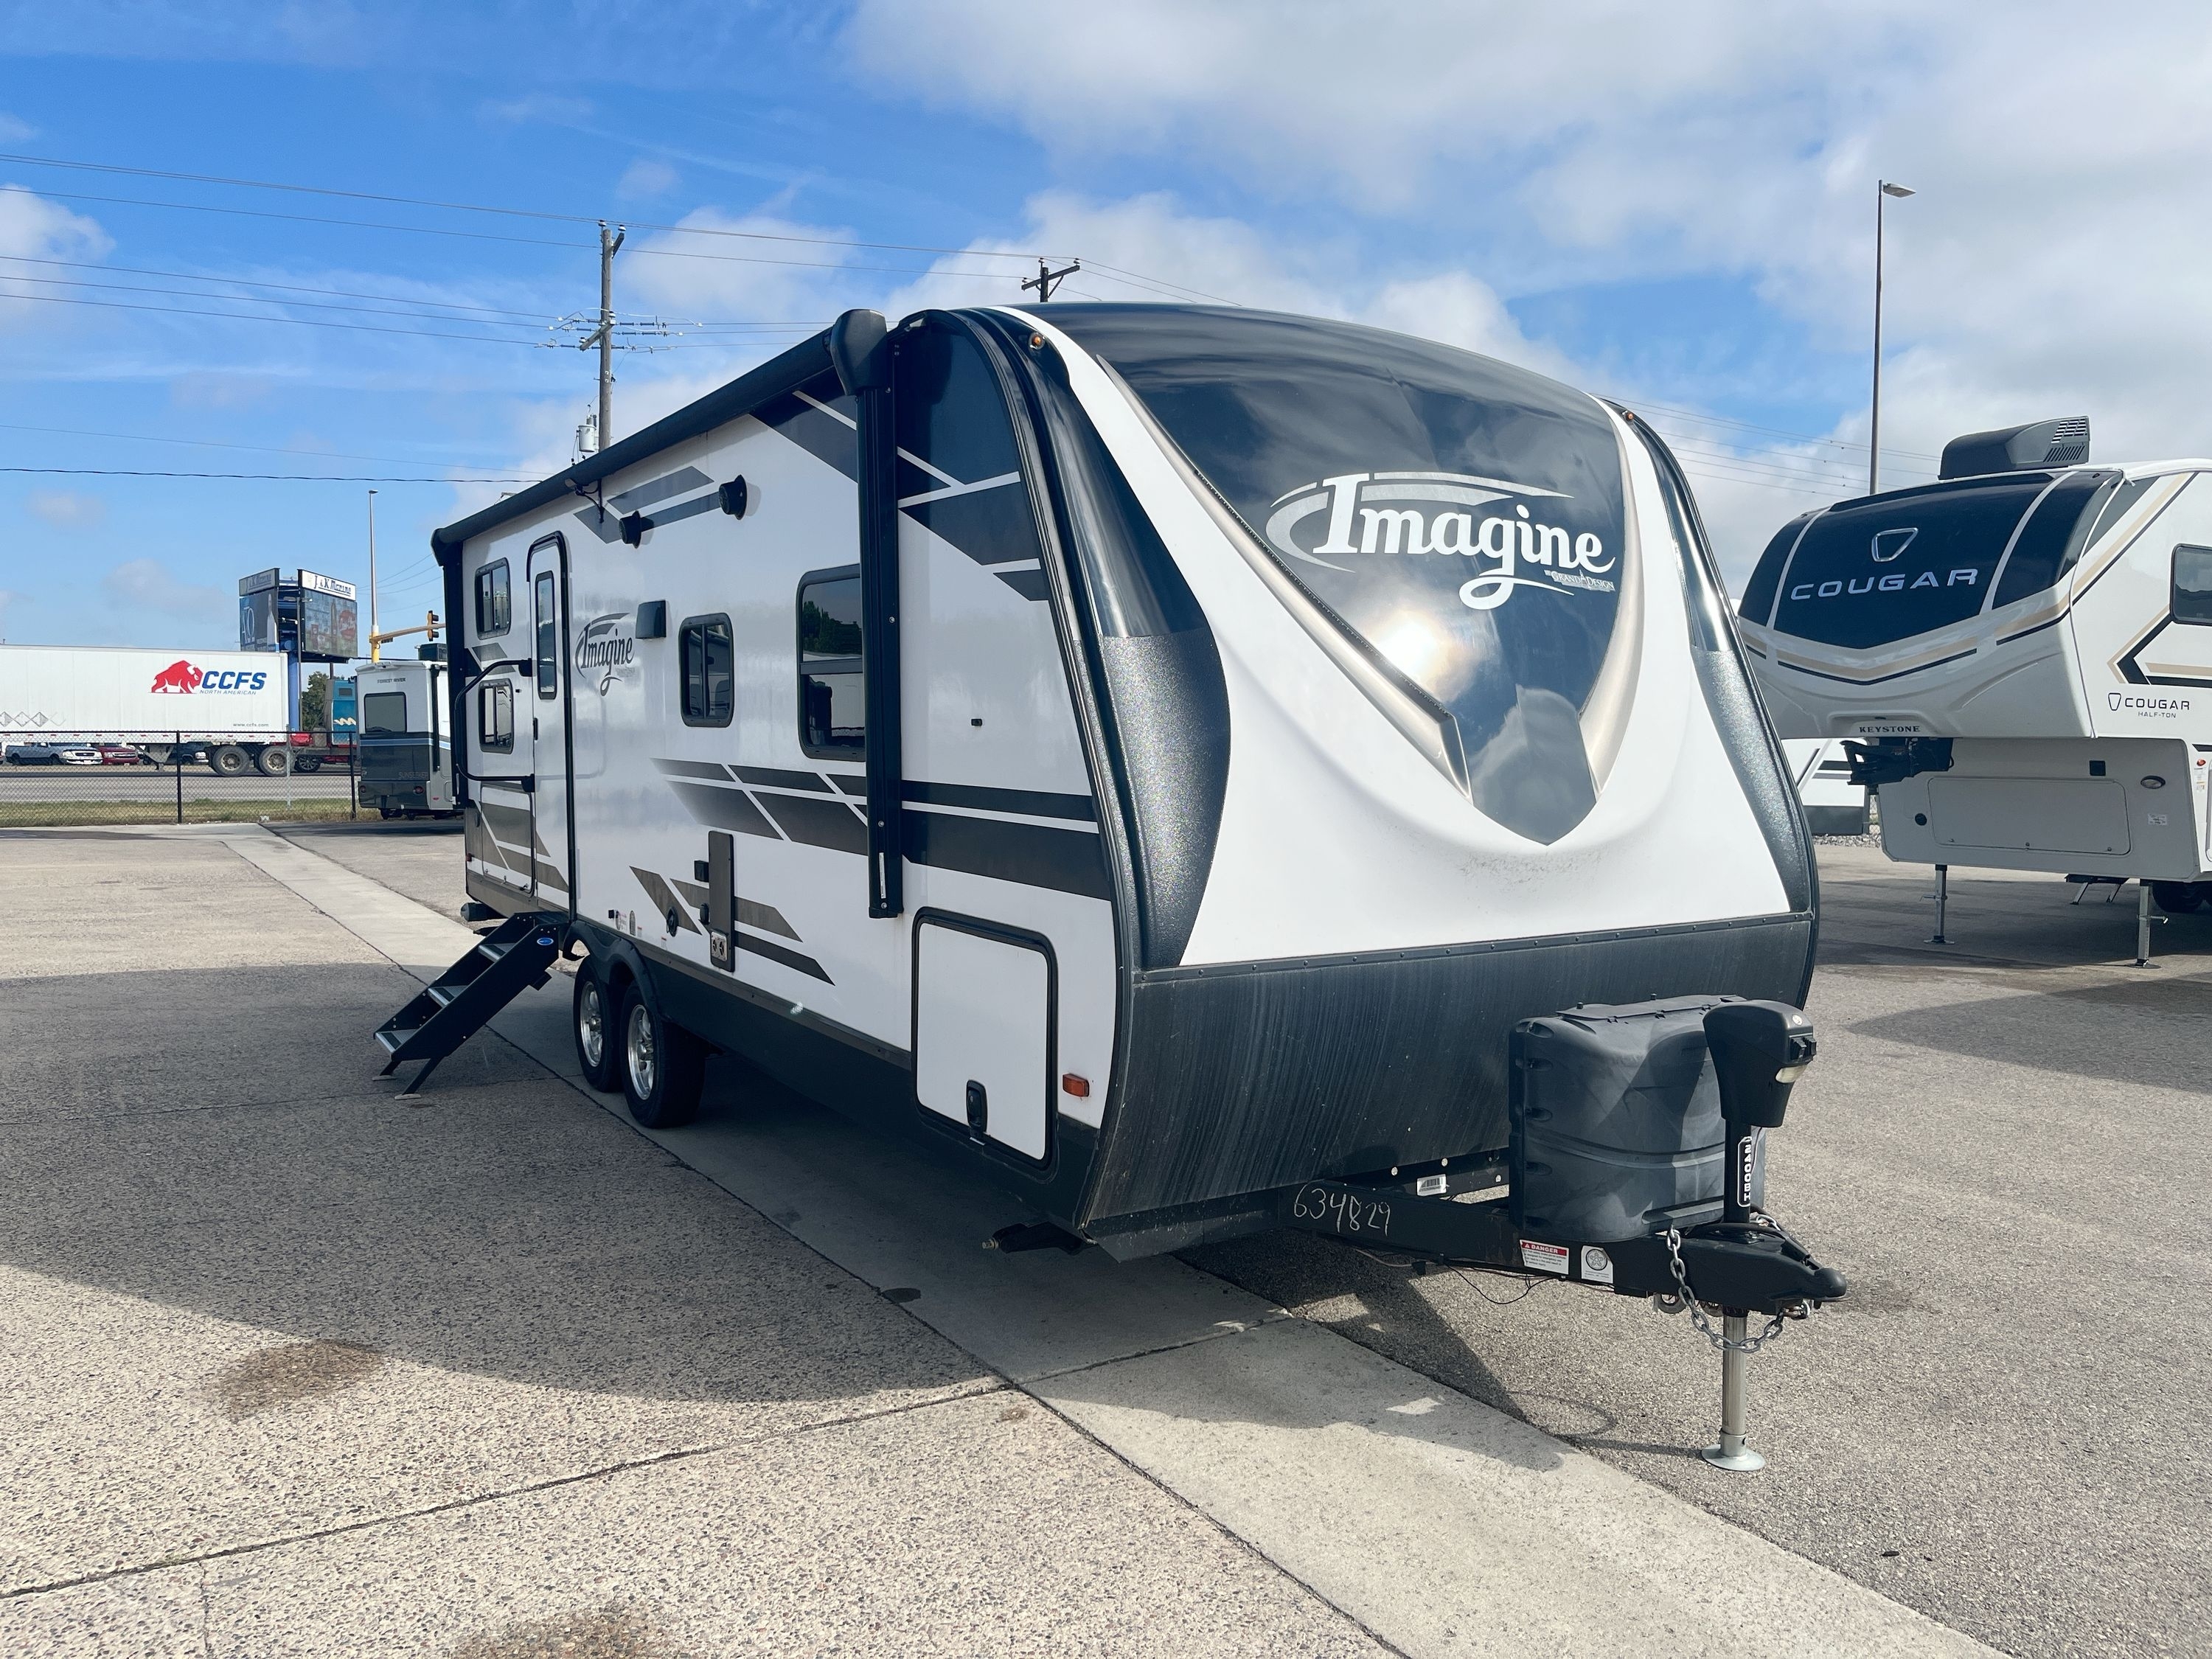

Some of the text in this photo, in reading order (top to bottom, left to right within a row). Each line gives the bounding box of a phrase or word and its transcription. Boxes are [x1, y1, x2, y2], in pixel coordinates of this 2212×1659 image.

[1312, 473, 1615, 610] Imagine
[314, 575, 318, 588] J
[324, 578, 330, 589] K
[1585, 576, 1615, 590] DESIGN
[1791, 568, 1978, 600] COUGAR
[580, 622, 635, 696] Imagine
[201, 671, 267, 690] CCFS
[2125, 698, 2190, 710] COUGAR
[1293, 1179, 1391, 1237] 634829
[1531, 1244, 1558, 1254] DANGER
